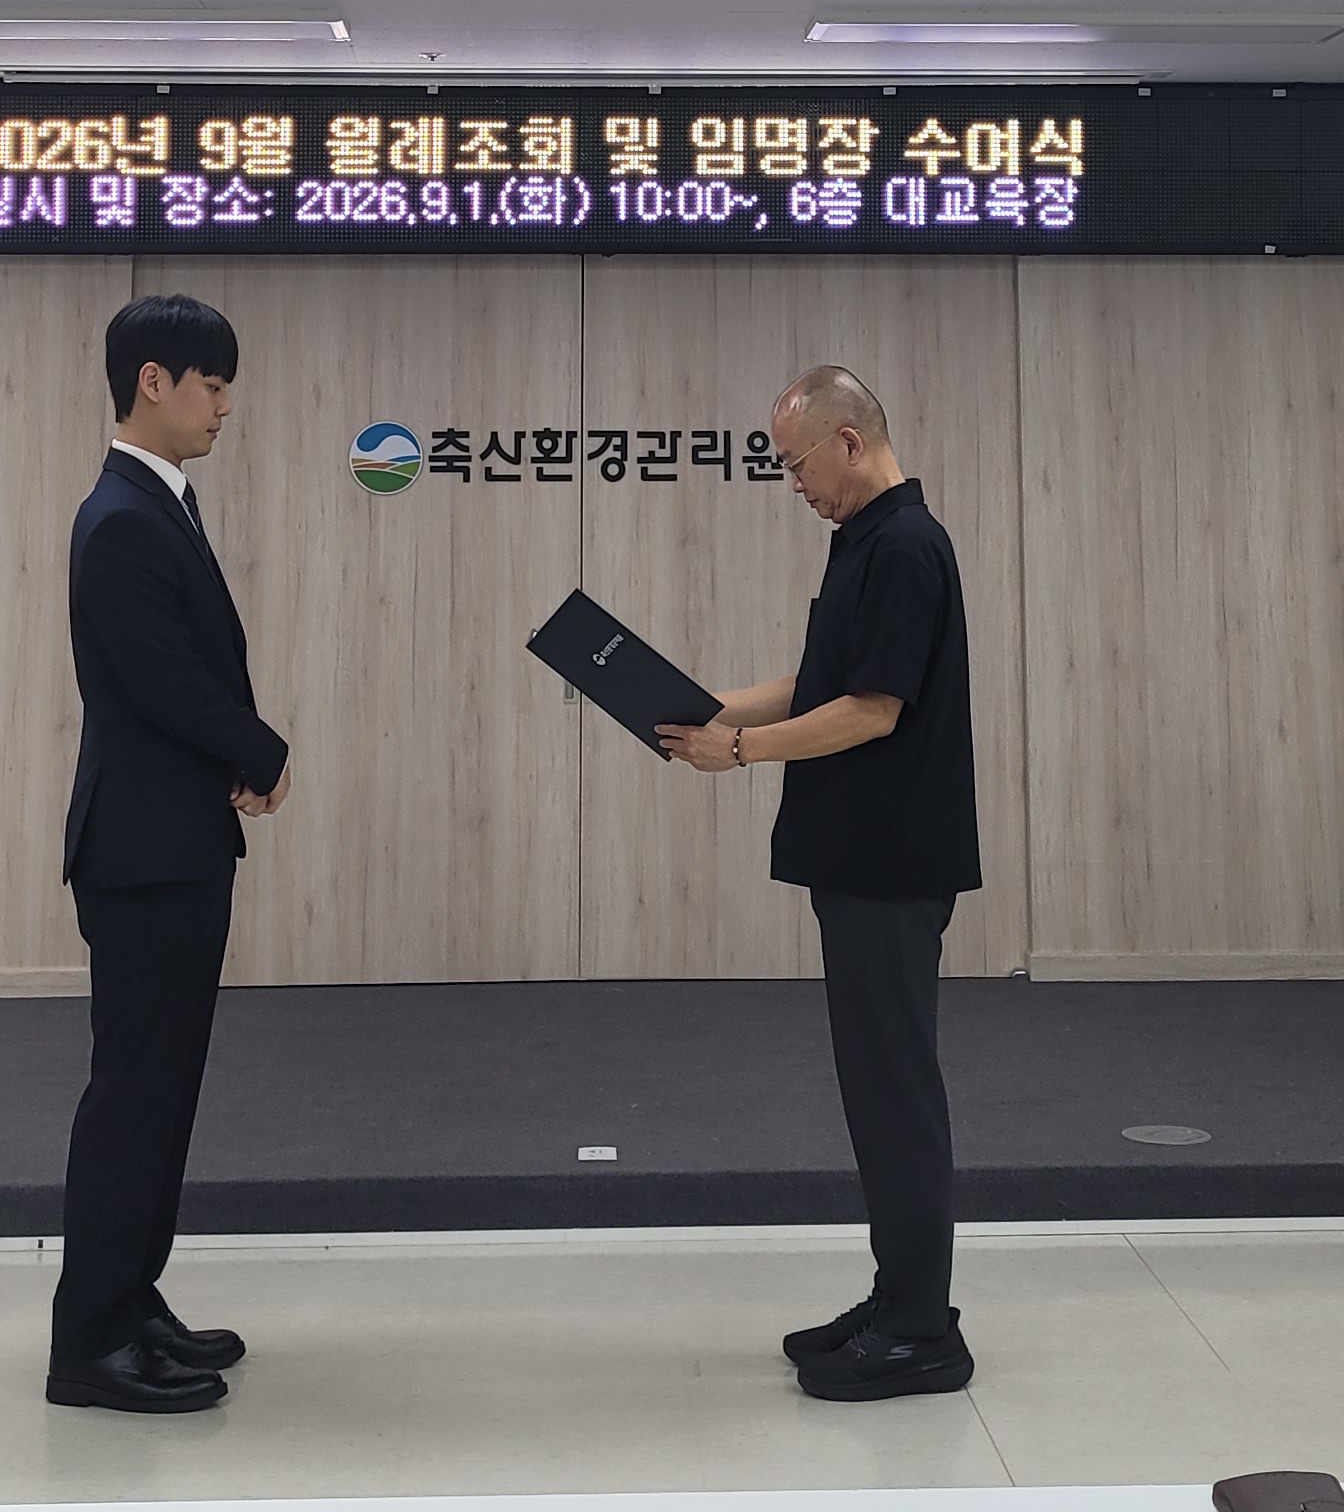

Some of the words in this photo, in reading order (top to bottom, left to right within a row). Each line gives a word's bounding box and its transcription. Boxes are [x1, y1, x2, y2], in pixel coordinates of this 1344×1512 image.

[198, 115, 295, 175] 9월
[326, 115, 573, 176] 월례조회
[604, 116, 660, 176] 및
[691, 117, 880, 176] 임명장
[903, 117, 1084, 176] 수여식
[89, 175, 136, 226] 및
[160, 175, 274, 226] 장소:
[790, 177, 862, 226] 6층
[884, 176, 1079, 226] 대교육장
[427, 427, 785, 483] 축산환경관리원
